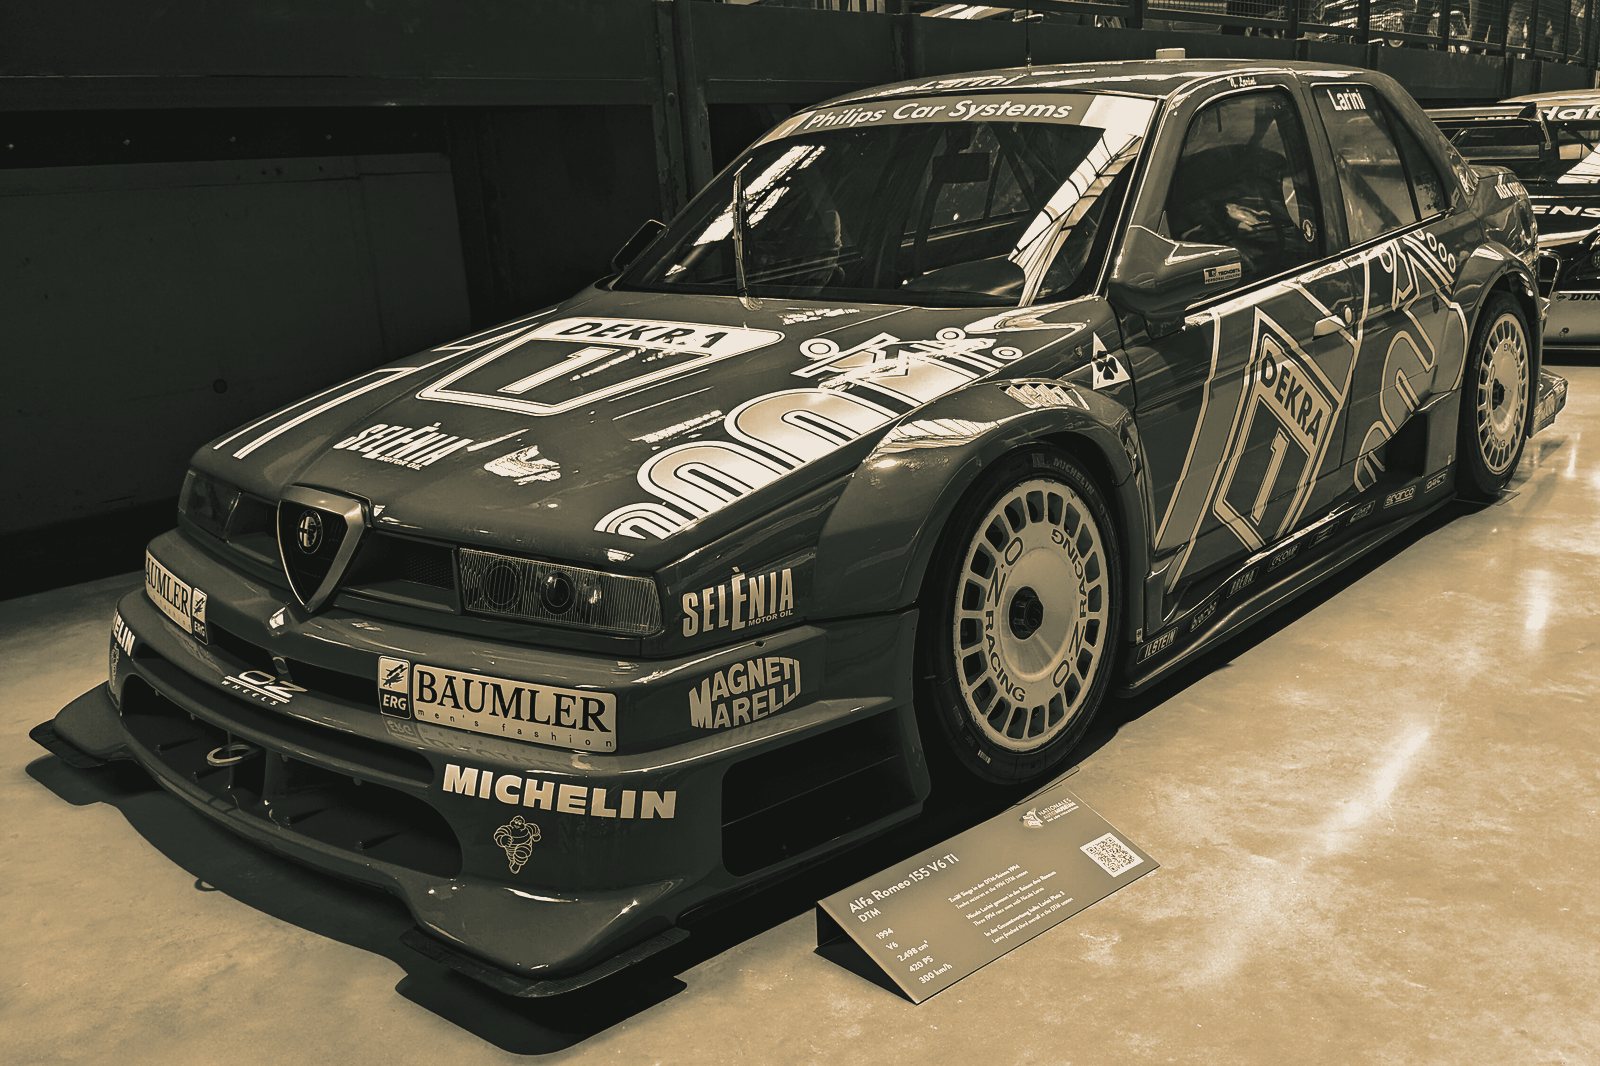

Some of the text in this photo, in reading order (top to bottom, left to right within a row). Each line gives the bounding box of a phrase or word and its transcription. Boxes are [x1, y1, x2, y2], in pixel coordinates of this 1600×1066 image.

[803, 99, 1073, 130] Philips Car Systems
[1326, 88, 1367, 111] Larini
[1542, 105, 1600, 120] daf
[1531, 204, 1600, 218] ENS
[1260, 349, 1324, 447] DEKRA
[1250, 427, 1291, 526] 1
[145, 557, 190, 618] AUMLER
[1051, 528, 1088, 619] RACING
[682, 566, 794, 638] SELÈNIA
[112, 607, 136, 657] ELIN
[748, 609, 794, 627] MOTOR OIL
[985, 610, 1027, 703] RACING
[1143, 629, 1177, 659] ILSTEIN
[221, 680, 279, 706] WHEELS
[382, 693, 408, 710] ERG
[689, 657, 800, 718] MAGNETI
[689, 668, 800, 729] MARELLI
[417, 709, 613, 748] men's fashion
[443, 763, 677, 819] MICHELIN
[850, 853, 959, 913] Alfa Romeo 155 V6 TI
[995, 880, 1006, 889] 1994
[1005, 875, 1016, 884] DTM
[1008, 864, 1020, 872] 1994
[858, 907, 881, 922] DTM
[876, 927, 894, 940] 1994
[886, 941, 898, 950] V6
[910, 955, 934, 972] 420 PS
[919, 963, 953, 984] 300 km/h
